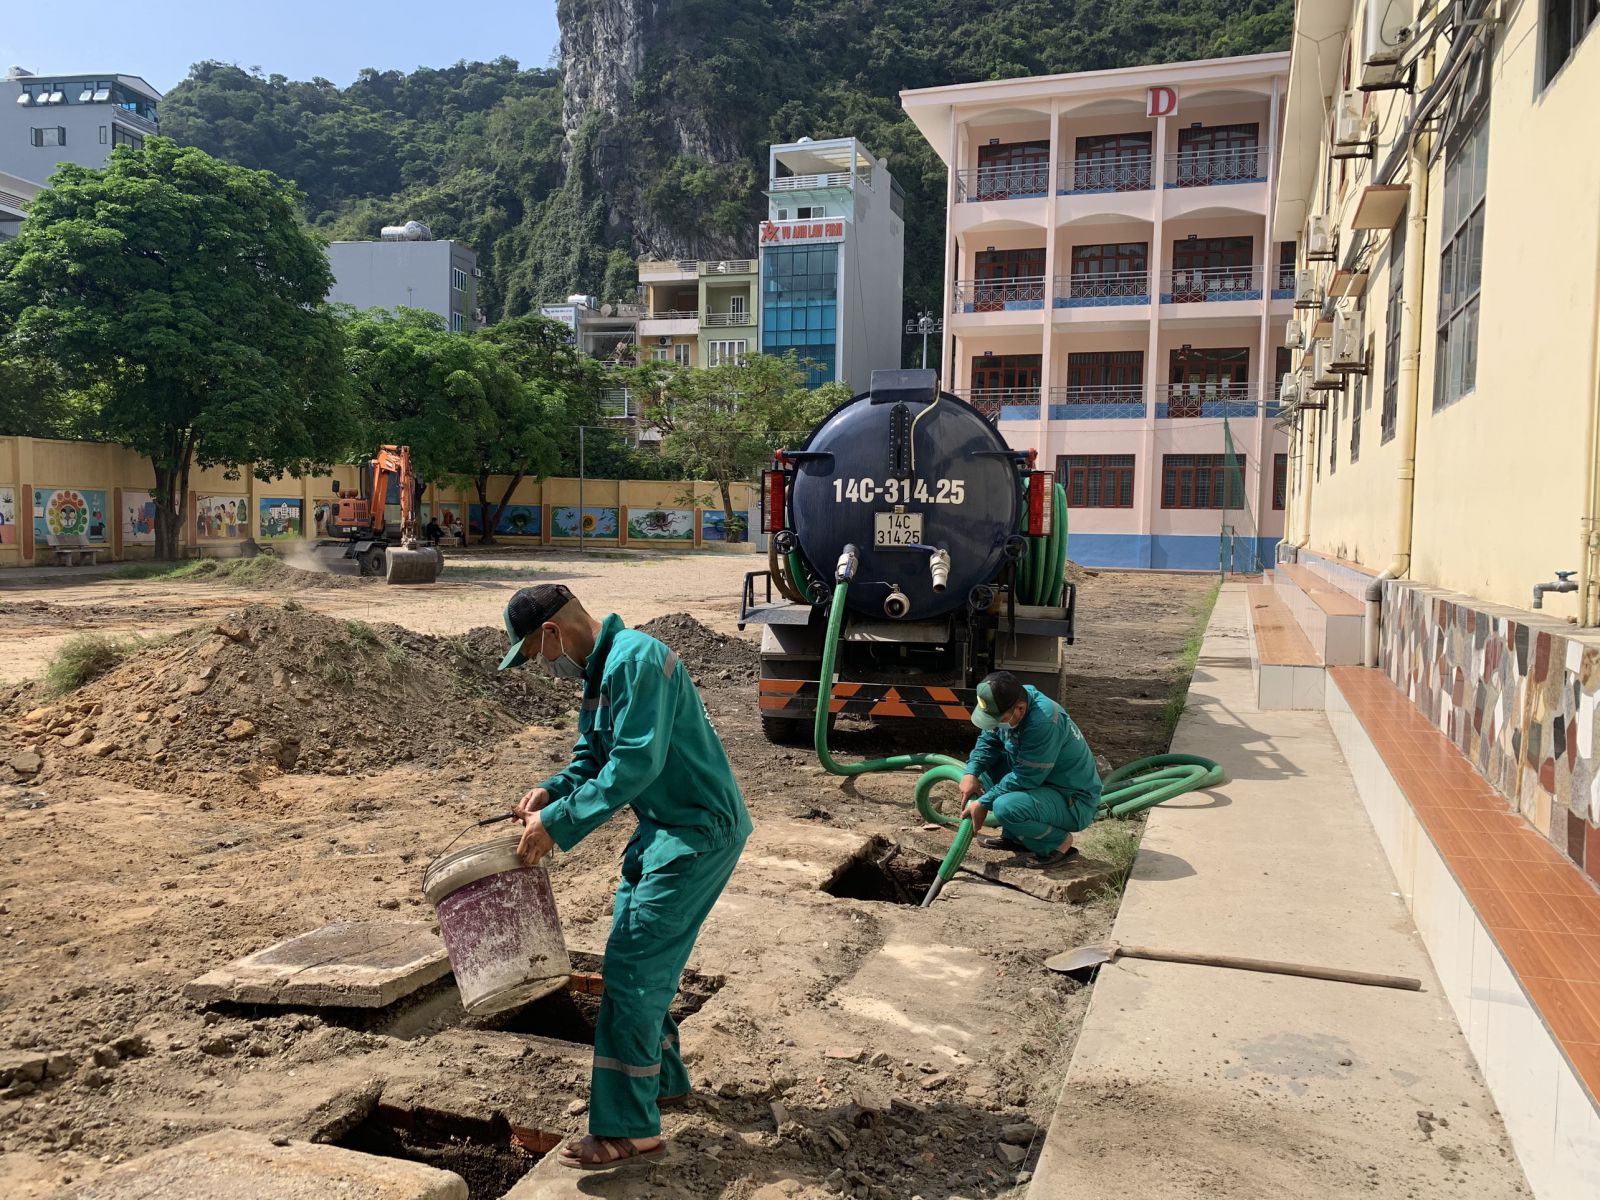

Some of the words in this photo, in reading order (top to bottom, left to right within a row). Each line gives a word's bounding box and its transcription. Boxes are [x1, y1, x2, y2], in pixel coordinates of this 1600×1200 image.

[1149, 87, 1176, 116] D
[808, 224, 823, 238] LAW
[825, 223, 842, 236] FIRM
[833, 478, 965, 504] 14C-314.25
[888, 515, 911, 529] 14C
[877, 531, 920, 545] 314.25
